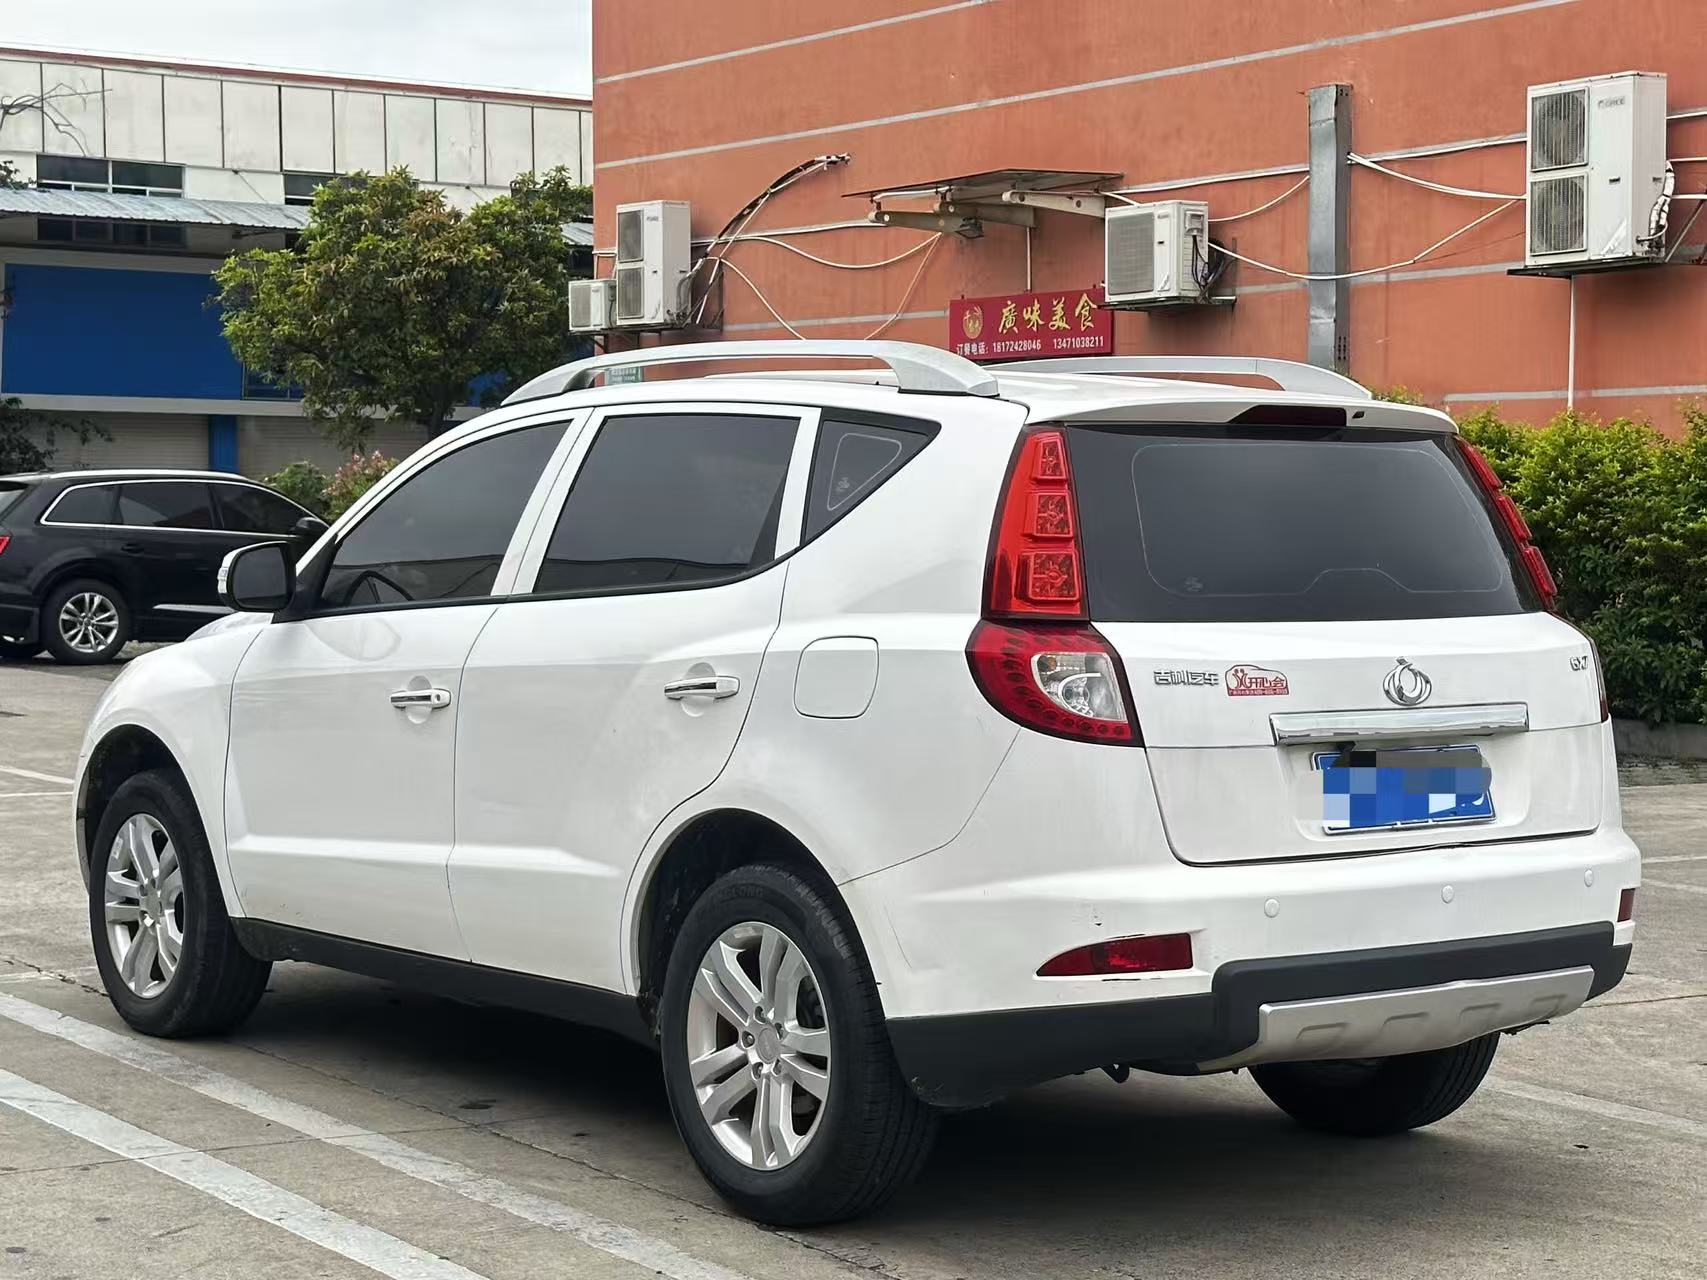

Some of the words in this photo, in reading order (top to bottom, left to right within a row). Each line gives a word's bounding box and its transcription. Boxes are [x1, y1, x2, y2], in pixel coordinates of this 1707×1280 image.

[999, 293, 1097, 334] 廣味美食
[993, 339, 1042, 353] 18172428046
[1053, 335, 1104, 349] 13471038211
